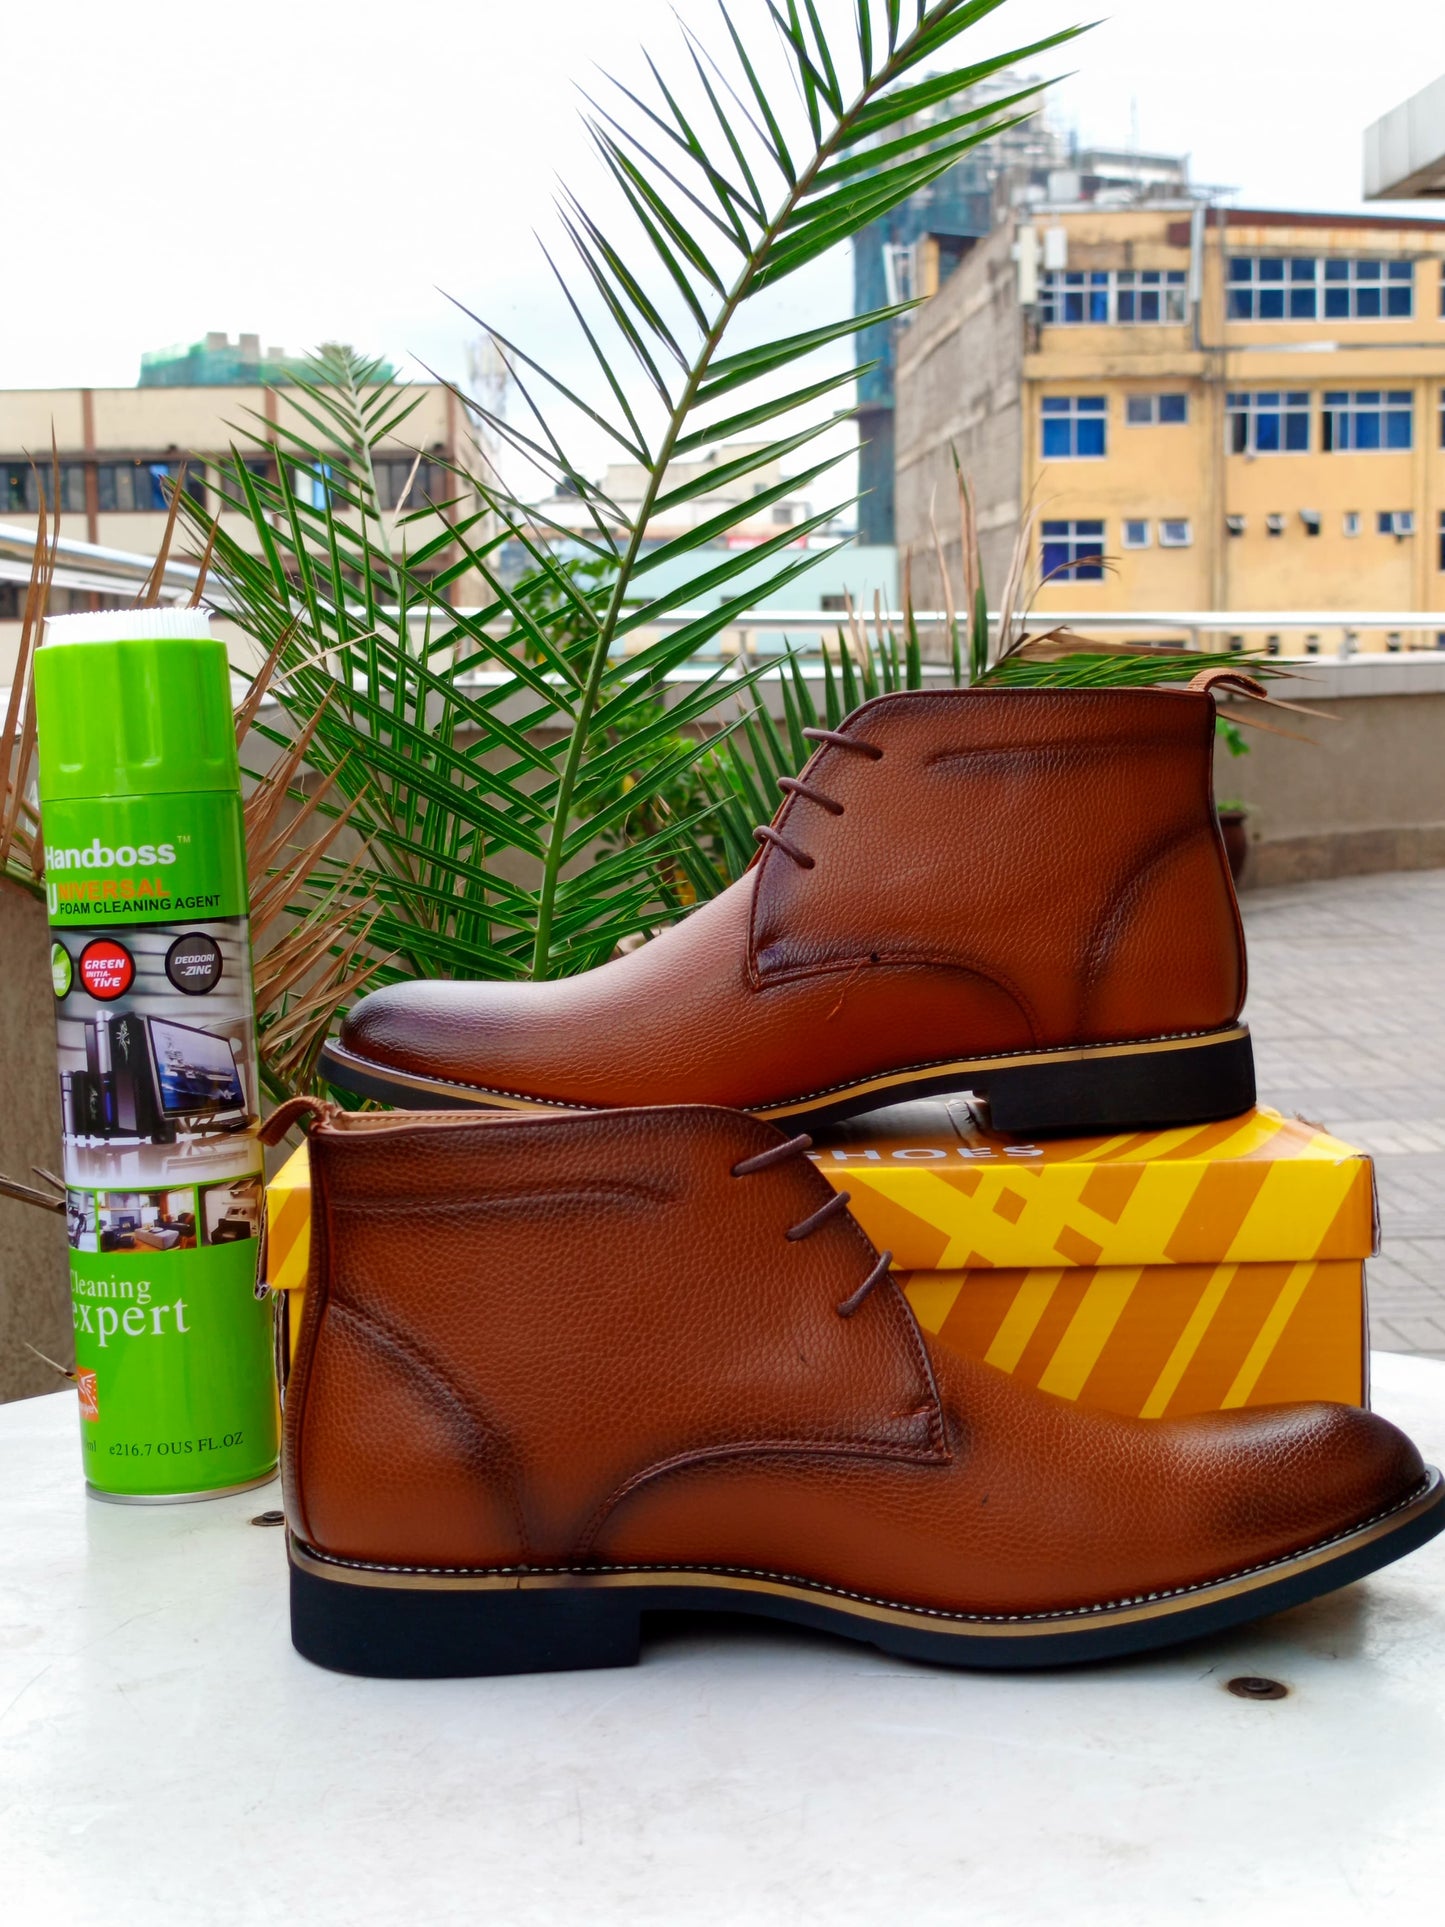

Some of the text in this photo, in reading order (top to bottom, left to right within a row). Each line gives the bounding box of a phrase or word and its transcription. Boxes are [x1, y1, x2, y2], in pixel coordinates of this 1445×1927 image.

[45, 838, 177, 870] Handboss
[60, 894, 221, 915] FOAM CLEANING AGENT
[84, 958, 125, 970] GREEN
[174, 953, 215, 965] DEODORI
[93, 976, 121, 988] TIVE
[198, 1431, 244, 1452] FL.OZ
